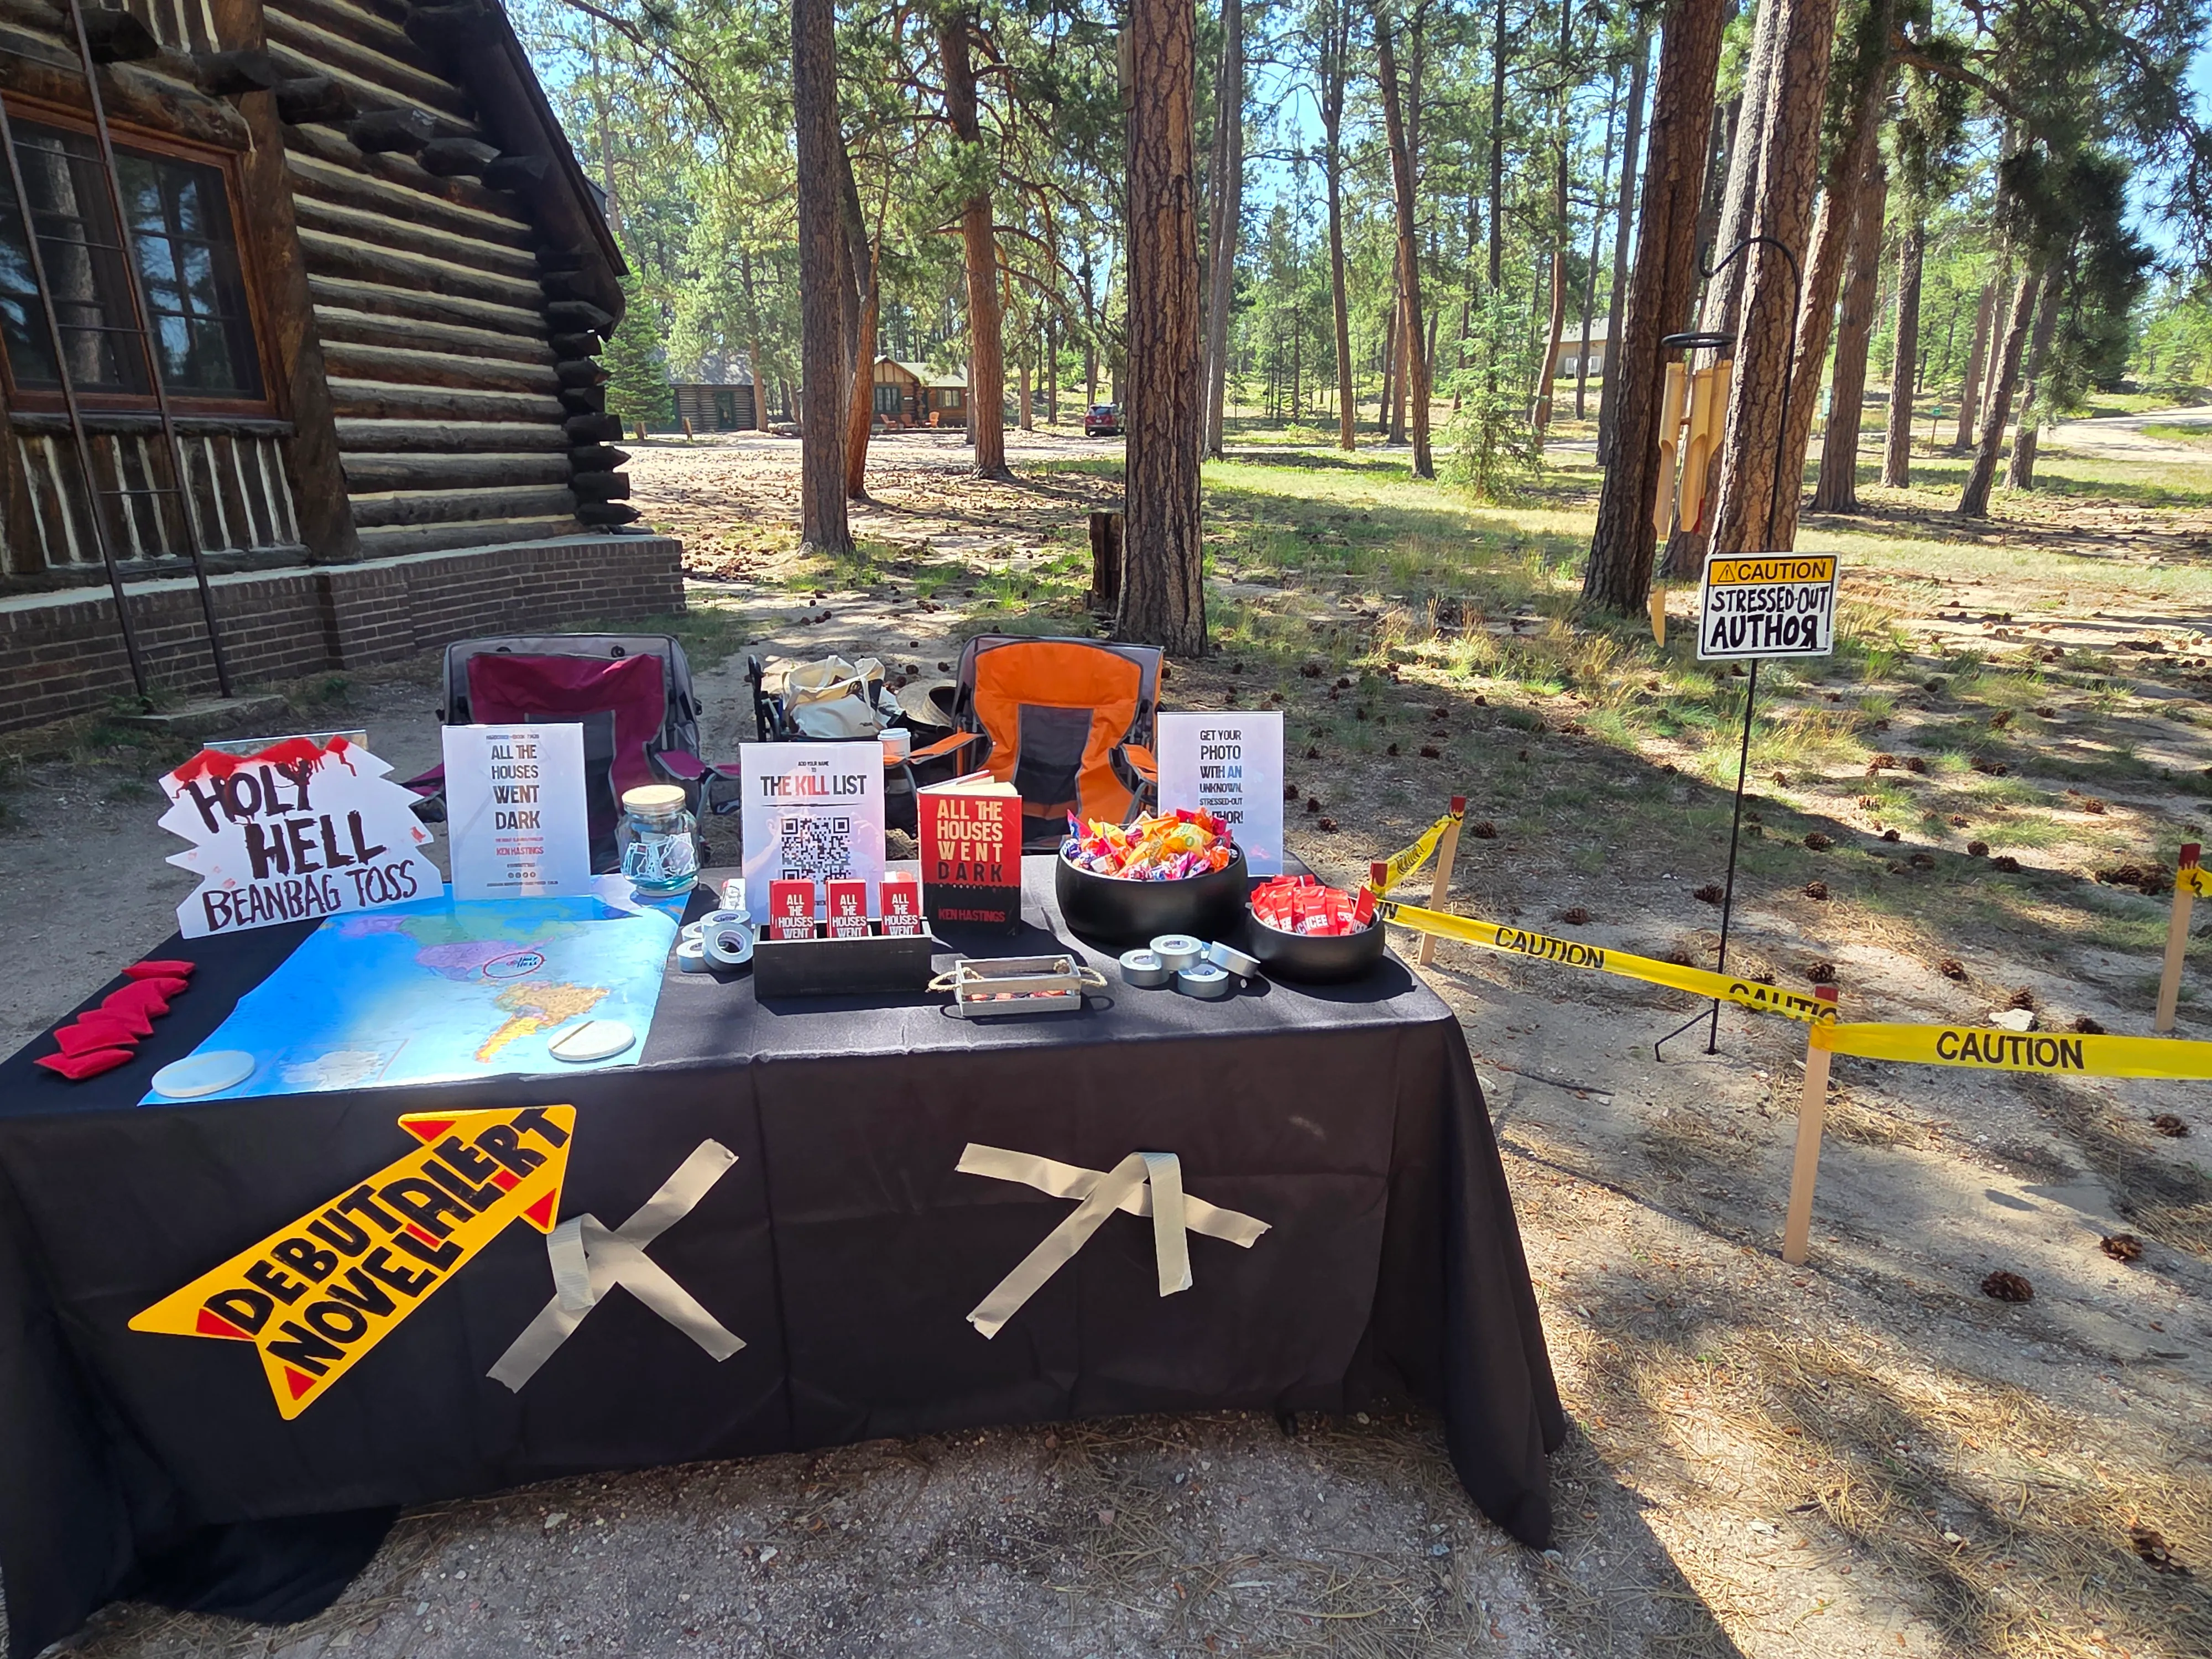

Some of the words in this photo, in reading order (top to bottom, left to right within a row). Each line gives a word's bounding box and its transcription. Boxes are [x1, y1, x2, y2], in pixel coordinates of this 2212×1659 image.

[1738, 562, 1826, 580] CAUTION
[1710, 586, 1829, 614] STRESSED-OUT
[1200, 730, 1216, 740] GET
[1218, 730, 1241, 740] YOUR
[491, 745, 514, 760] ALL
[515, 744, 537, 759] THE
[1201, 745, 1241, 760] PHOTO
[492, 765, 538, 779] HOUSES
[1200, 765, 1225, 779] WITH
[1227, 765, 1242, 779] AN
[760, 776, 791, 796] THE
[795, 775, 830, 796] KILL
[833, 775, 867, 795] LIST
[189, 759, 314, 833] HOLY
[493, 785, 539, 804] WENT
[937, 800, 969, 820] ALL
[975, 801, 1003, 821] THE
[495, 811, 540, 830] DARK
[937, 820, 1003, 841] HOUSES
[245, 810, 387, 879] HELL
[496, 847, 510, 855] KEN
[511, 846, 544, 855] HASTINGS
[938, 841, 1003, 863] WENT
[938, 860, 1002, 882] DARK
[202, 874, 341, 931] BEANBAG
[346, 860, 418, 907] TOSS
[786, 894, 805, 905] ALL
[840, 894, 857, 905] ALL
[891, 894, 909, 904] ALL
[788, 905, 803, 916] THE
[842, 905, 857, 916] THE
[893, 904, 907, 915] THE
[938, 908, 957, 920] KEN
[958, 909, 1005, 922] HASTINGS
[778, 916, 813, 927] HOUSES
[832, 916, 867, 927] HOUSES
[884, 915, 918, 926] HOUSES
[1306, 914, 1328, 931] ICEE
[783, 928, 809, 938] WENT
[837, 927, 862, 937] WENT
[889, 926, 914, 936] WENT
[1495, 927, 1605, 969] CAUTION
[1937, 1031, 2084, 1069] CAUTION
[378, 1108, 571, 1239] ALERT
[203, 1184, 403, 1335] DEBUT
[265, 1240, 465, 1377] NOVEL
